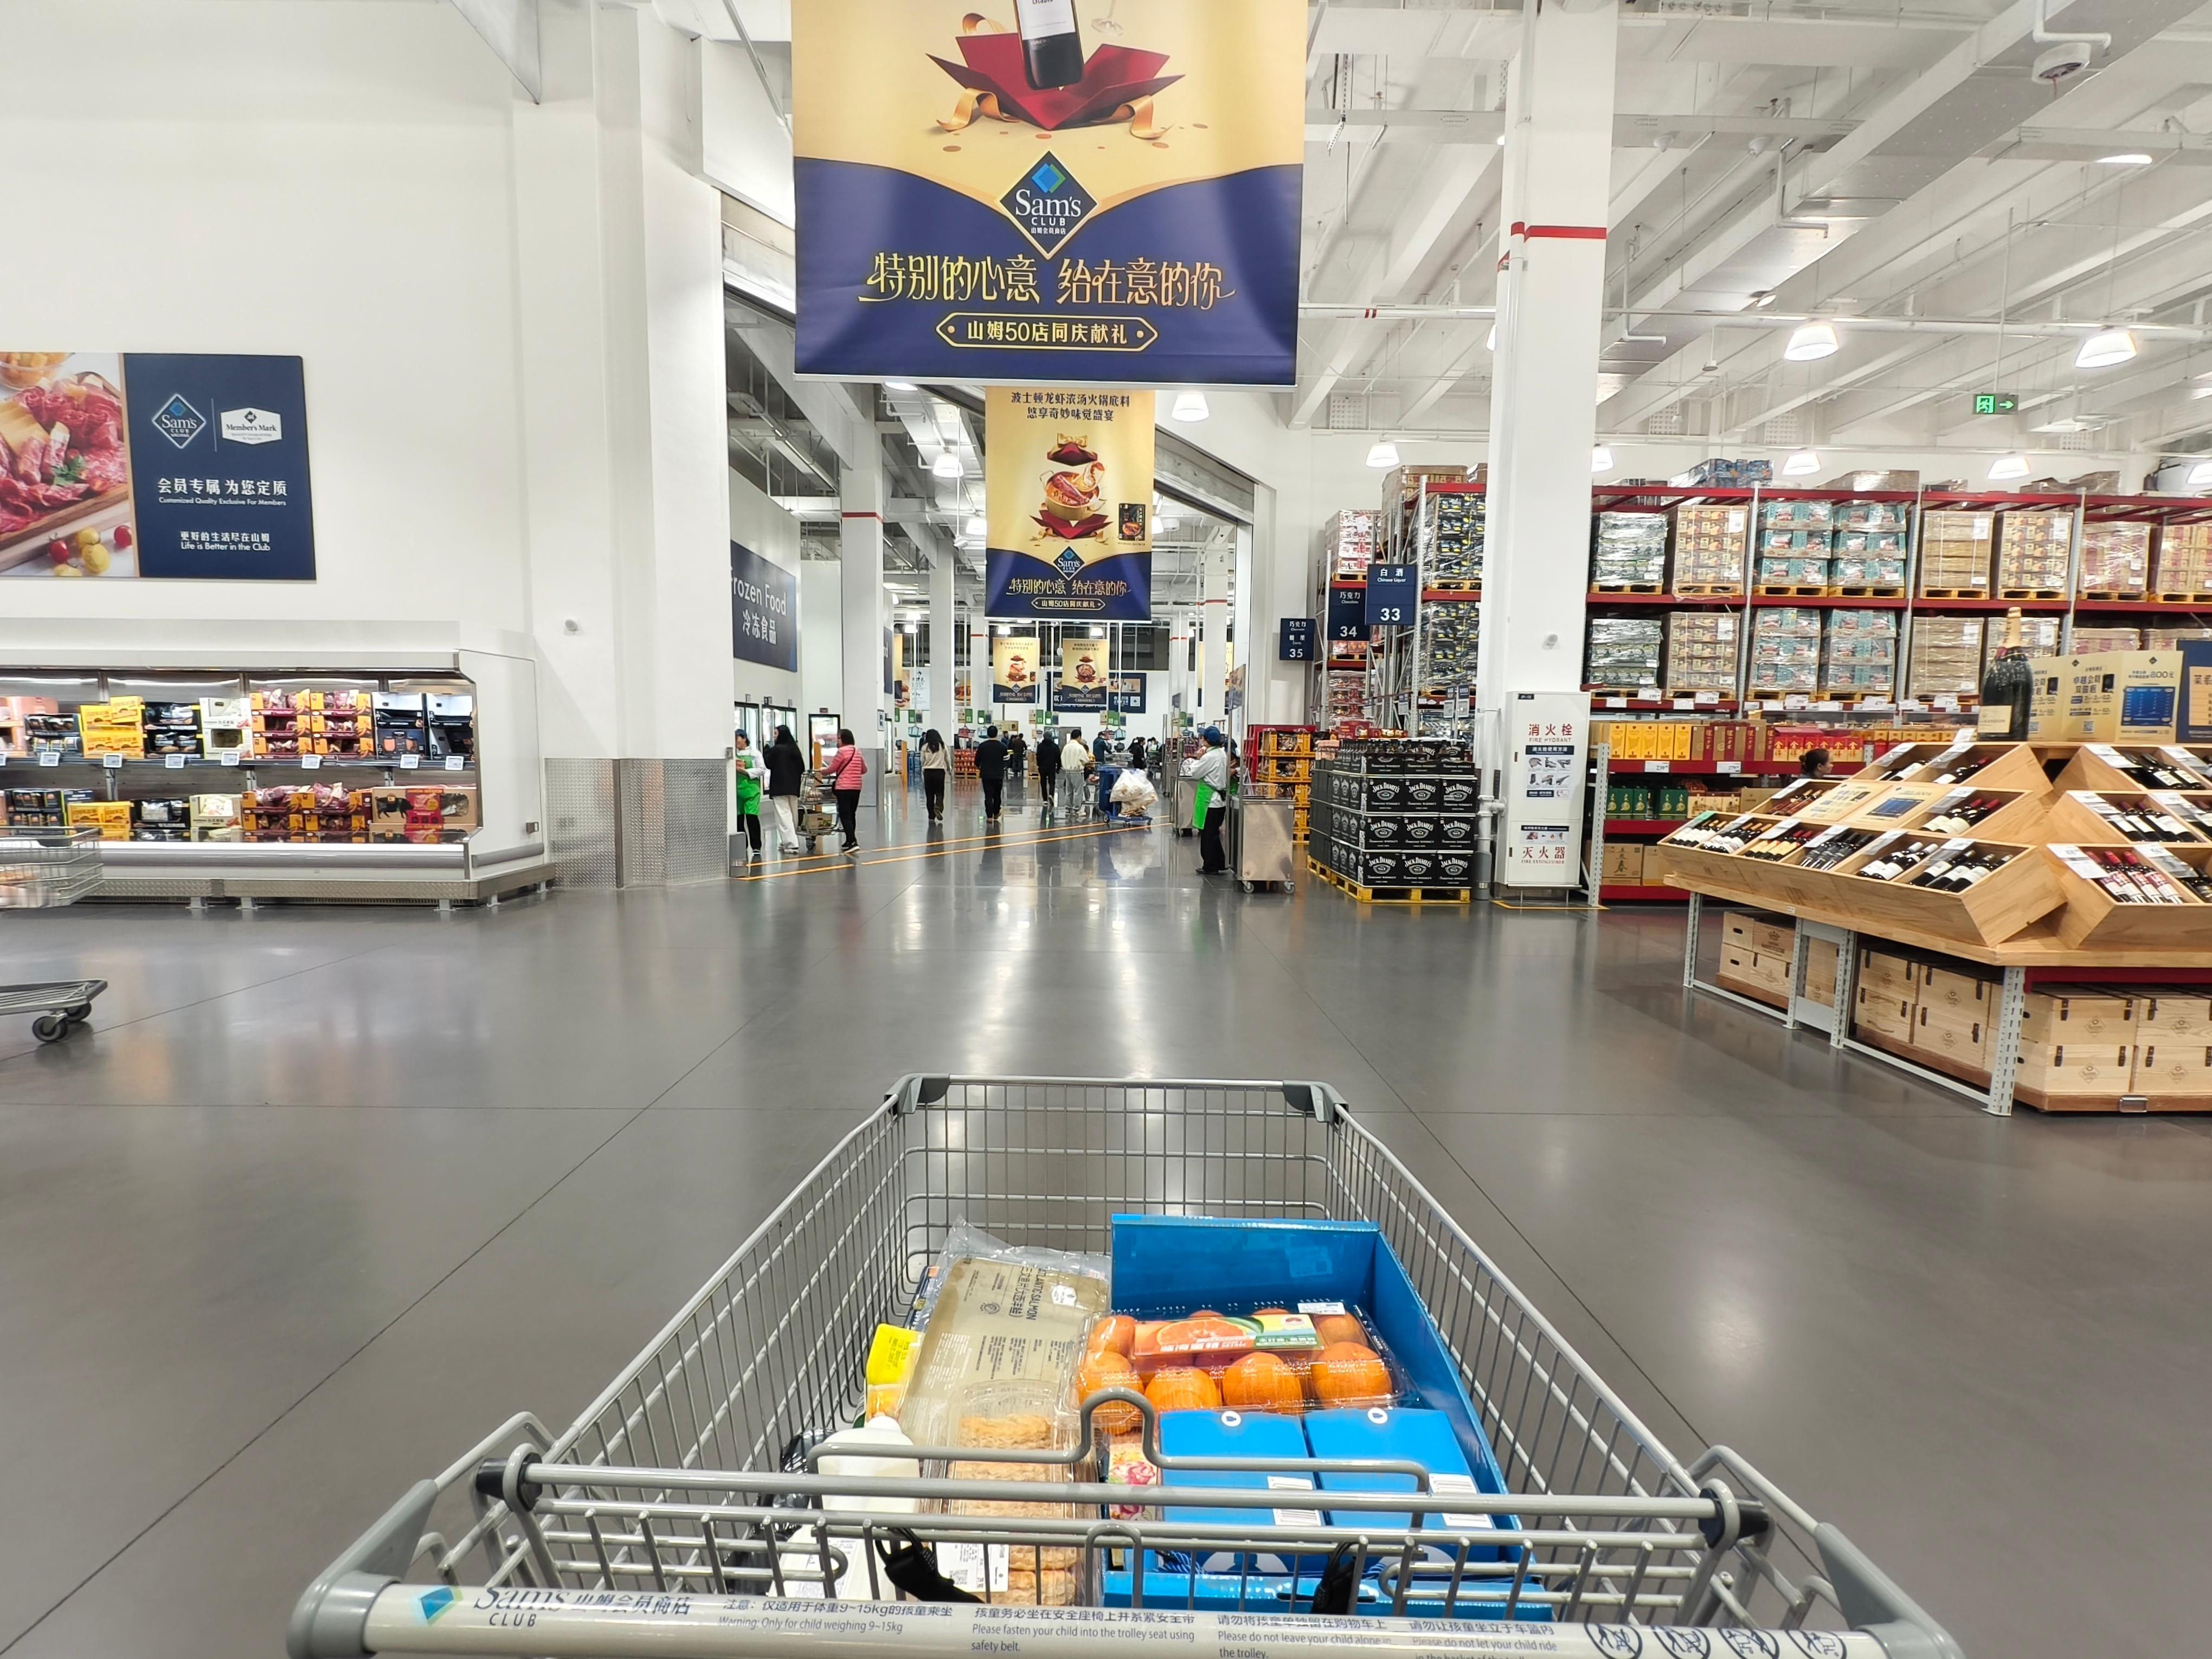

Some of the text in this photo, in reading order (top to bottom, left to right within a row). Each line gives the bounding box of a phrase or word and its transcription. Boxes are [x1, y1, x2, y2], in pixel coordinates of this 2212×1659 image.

[1016, 189, 1081, 217] Sam's
[1032, 217, 1066, 226] CLUB
[859, 252, 1236, 310] 特别的心意 给在意的你
[967, 319, 1128, 345] 山姆50店同庆献礼
[1012, 392, 1130, 407] 波士顿龙虾浓汤火锅底料
[162, 415, 197, 429] Sam's
[226, 423, 258, 432] Member's
[158, 478, 287, 496] 会员专属 为您定质
[180, 531, 270, 543] 更好的生活尽在山姆
[205, 542, 228, 550] Better
[1058, 558, 1080, 568] Sam's
[1380, 568, 1403, 577] 白酒
[1006, 578, 1131, 597] 特别的心意 给在意的你
[731, 576, 787, 616] rozen Food
[1380, 608, 1400, 621] 33
[743, 609, 776, 645] 冷冻食品
[1340, 626, 1357, 638] 34
[1289, 649, 1303, 658] 35
[1529, 724, 1572, 736] 消火栓
[1522, 846, 1565, 859] 灭火器
[1026, 1267, 1046, 1320] ATLANTIC SALMON
[489, 1613, 537, 1626] CLUB
[719, 1616, 903, 1635] Warning: Only for child weighing 9~15kg
[972, 1623, 1194, 1643] Please fasten your child into the trolley seat using
[1218, 1630, 1247, 1642] Please
[1249, 1631, 1262, 1642] do
[1264, 1631, 1279, 1643] not
[1281, 1632, 1306, 1643] leave
[1308, 1635, 1328, 1646] your
[1330, 1634, 1353, 1644] child
[1355, 1635, 1381, 1645] alone
[972, 1641, 1021, 1653] safety belt.
[1413, 1637, 1558, 1651] Please do not let your child ride
[1219, 1647, 1269, 1659] the trolley.
